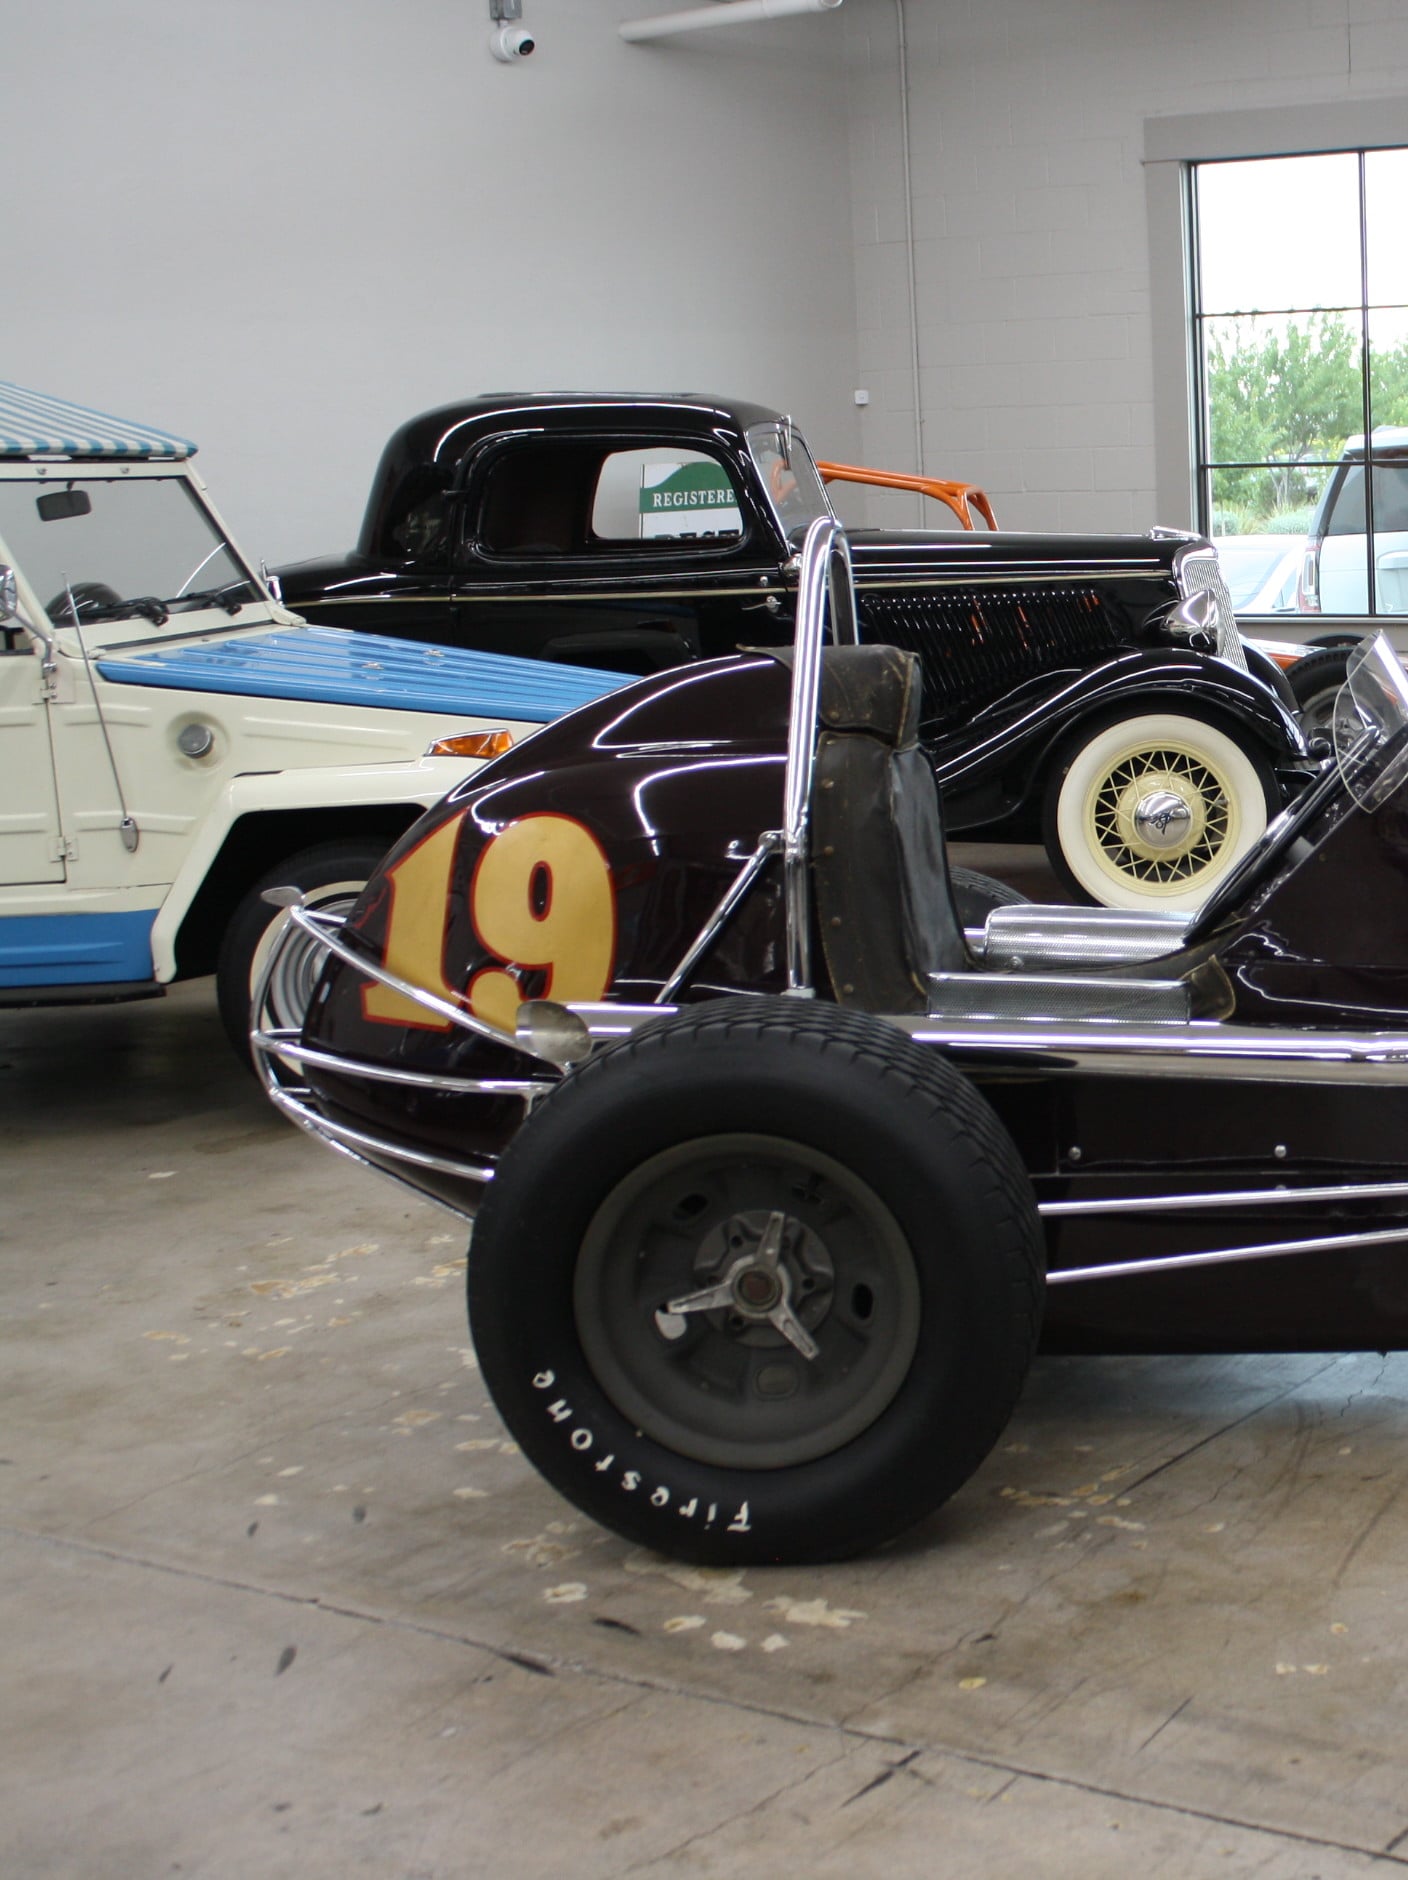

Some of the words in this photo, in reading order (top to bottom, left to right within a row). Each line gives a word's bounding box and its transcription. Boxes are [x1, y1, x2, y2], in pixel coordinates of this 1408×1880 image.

[653, 488, 736, 507] REGISTERE
[360, 805, 617, 1033] 19
[532, 1368, 752, 1533] Firestone
